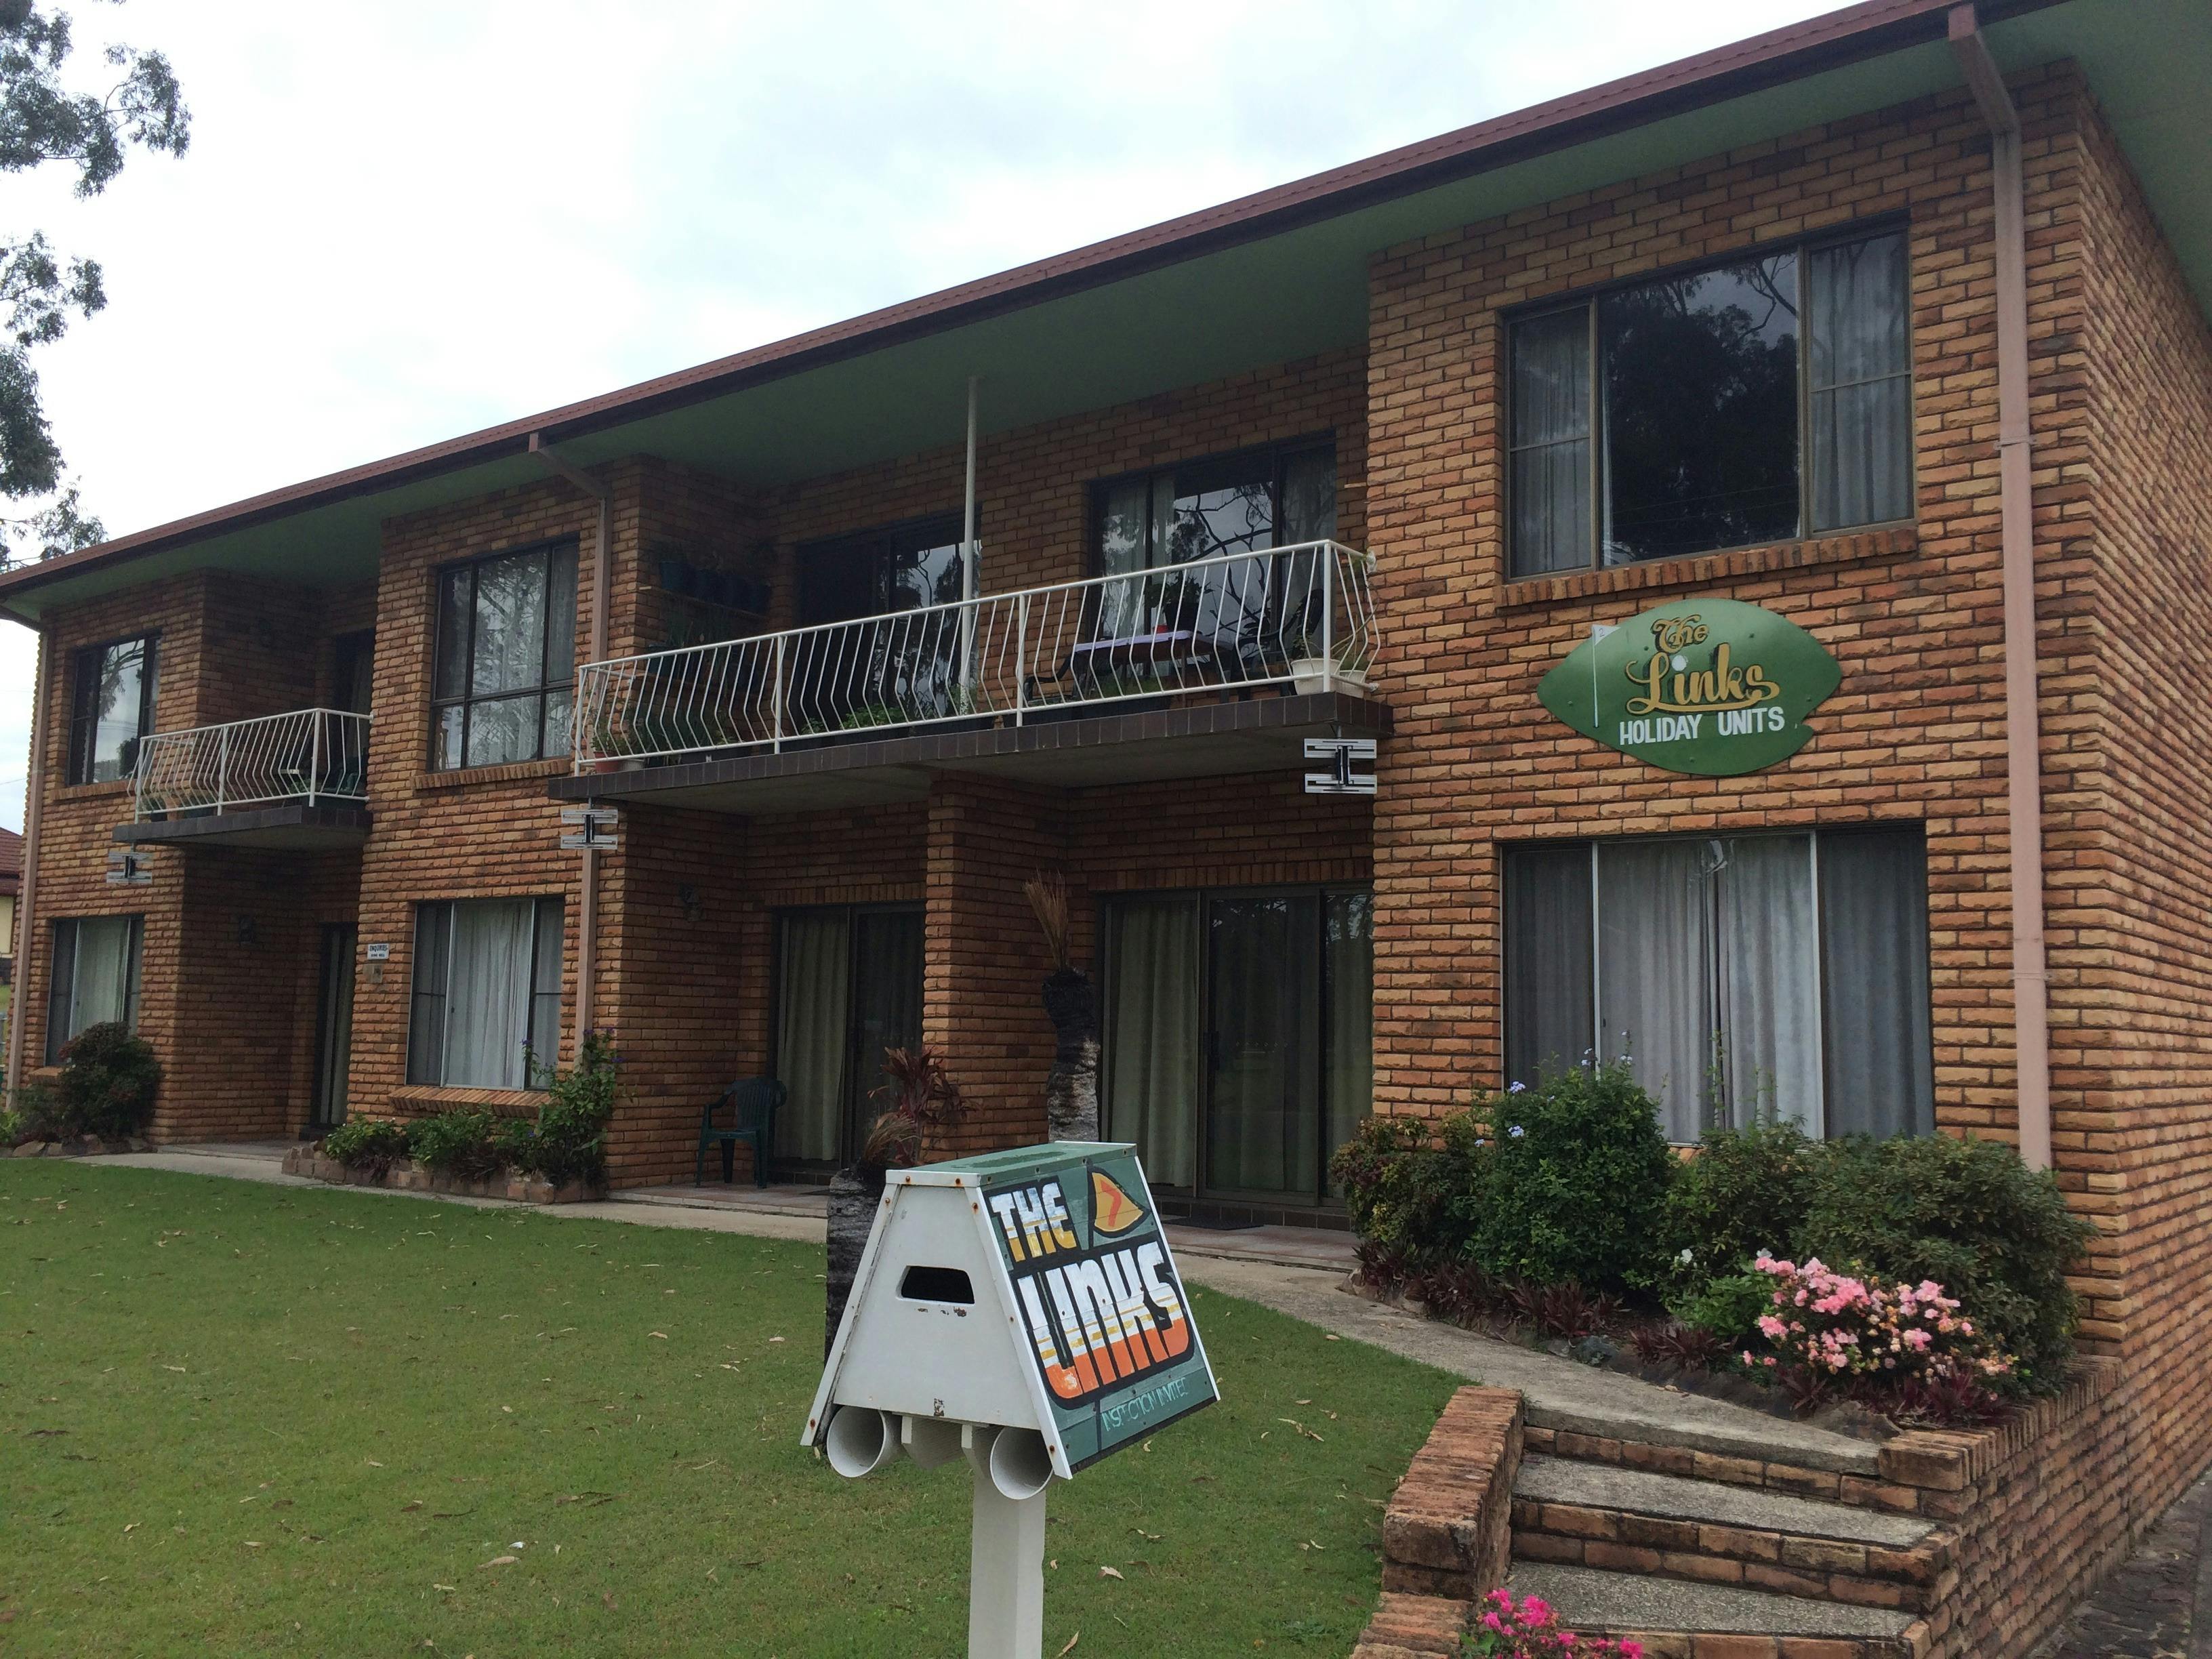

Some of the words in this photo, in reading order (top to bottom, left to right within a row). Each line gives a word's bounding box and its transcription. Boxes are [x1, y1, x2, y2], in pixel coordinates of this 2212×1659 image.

[1651, 614, 1709, 654] The
[1626, 642, 1780, 714] Links
[1620, 715, 1702, 745] HOLIDAY
[1717, 707, 1785, 736] UNITS
[989, 1182, 1076, 1261] THE
